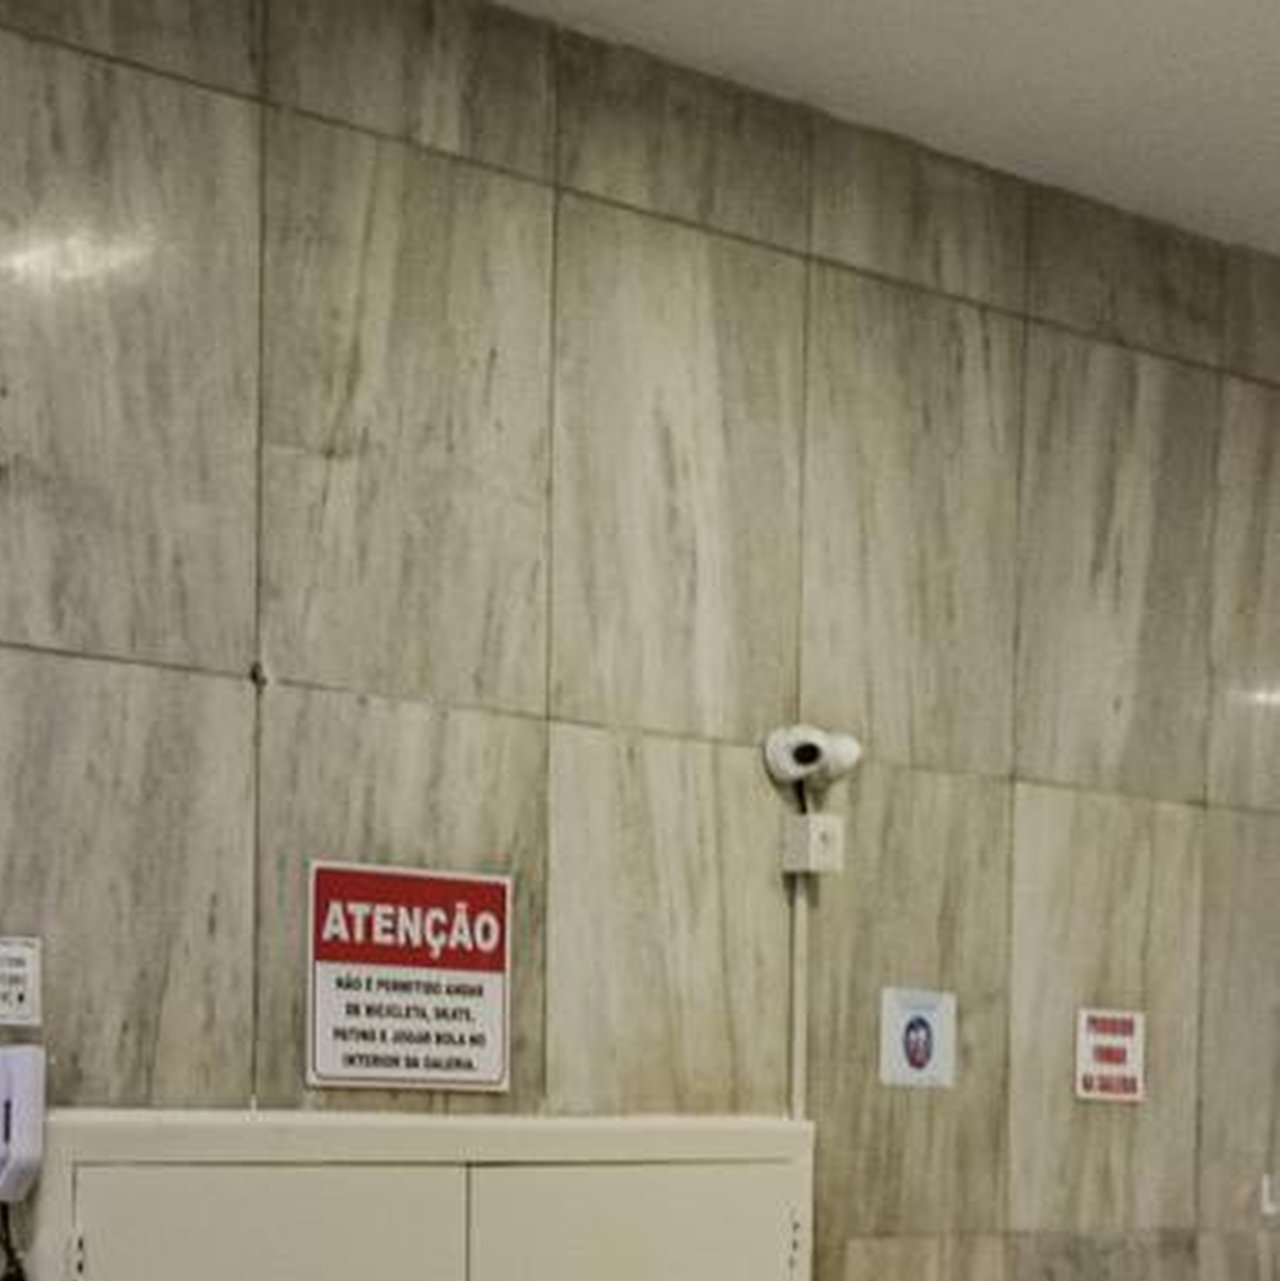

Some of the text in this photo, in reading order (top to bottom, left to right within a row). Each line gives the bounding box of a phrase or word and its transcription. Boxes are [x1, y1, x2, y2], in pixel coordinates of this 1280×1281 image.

[321, 900, 501, 959] ATENÇÃO
[335, 974, 362, 991] NÃO
[376, 979, 441, 996] PERMITIDO
[345, 1002, 360, 1017] DE
[435, 1031, 466, 1047] BOLA
[469, 1033, 487, 1048] NO
[404, 1055, 420, 1069] DA
